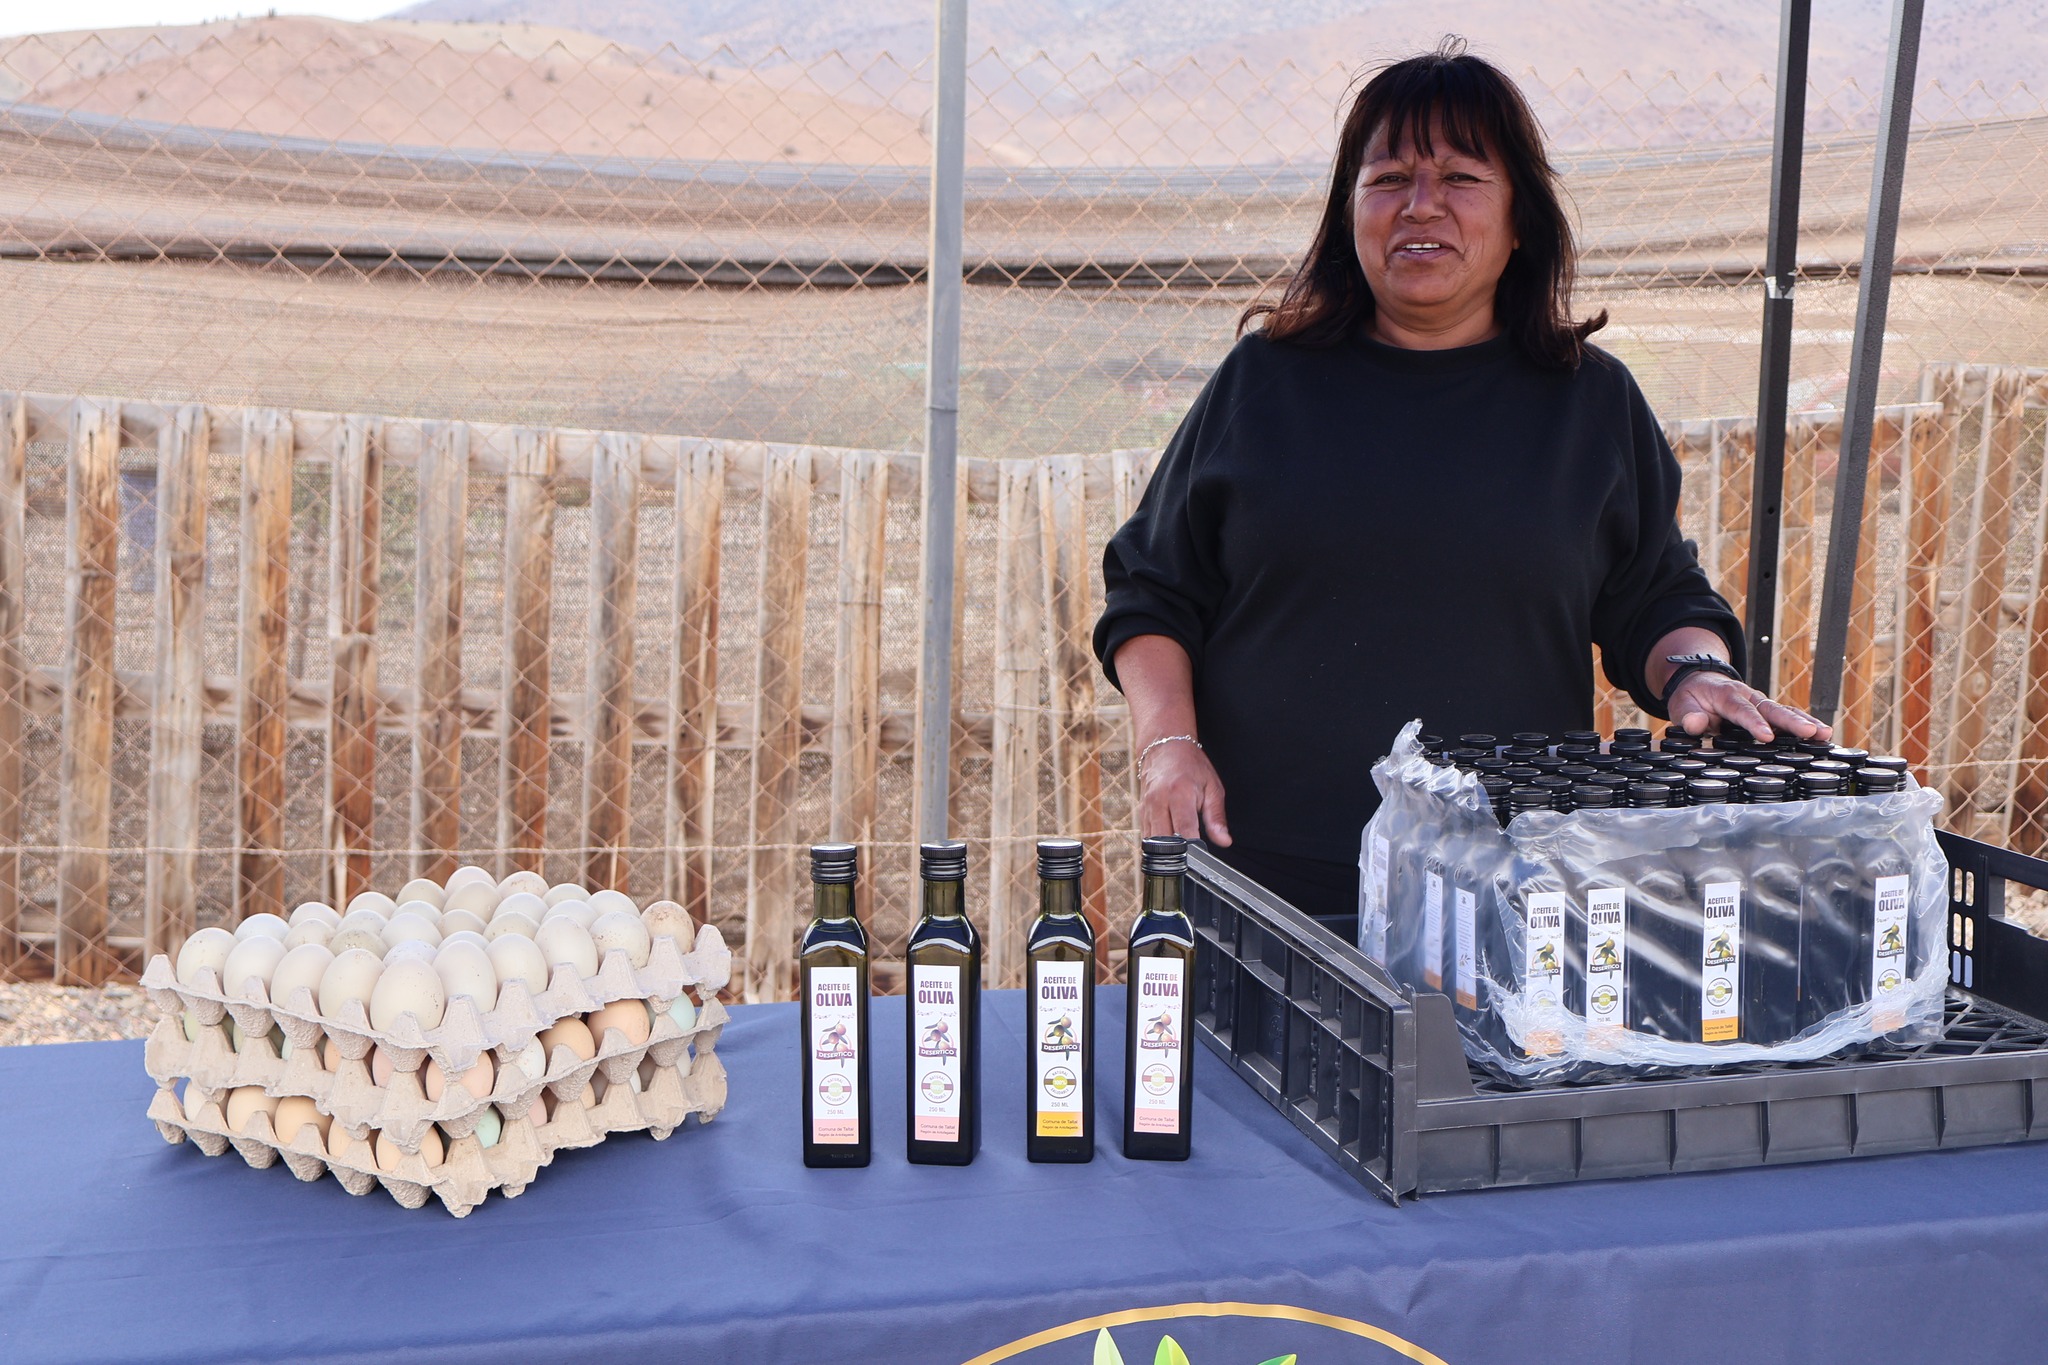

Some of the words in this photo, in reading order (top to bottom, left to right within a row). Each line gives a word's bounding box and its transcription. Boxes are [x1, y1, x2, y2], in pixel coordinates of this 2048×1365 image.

[1880, 890, 1898, 898] ACEITE
[1708, 897, 1726, 905] ACEITE
[1727, 896, 1734, 904] DE
[1878, 898, 1905, 912] OLIVA
[1532, 907, 1552, 915] ACEITE
[1593, 903, 1612, 911] ACEITE
[1706, 905, 1735, 919] OLIVA
[1530, 915, 1560, 929] OLIVA
[1591, 912, 1621, 925] OLIVA
[1707, 955, 1735, 965] DESERTICO
[1145, 973, 1168, 981] ACEITE
[1169, 974, 1178, 982] DE
[920, 981, 943, 989] ACEITE
[1143, 982, 1179, 997] OLIVA
[918, 990, 954, 1004] OLIVA
[1041, 986, 1078, 1000] OLIVA
[816, 993, 852, 1006] OLIVA
[1044, 1043, 1078, 1051] DESERTICO
[1143, 1040, 1177, 1048] DESERTICO
[818, 1050, 853, 1058] DESERTICO
[921, 1048, 955, 1056] DESERTICO
